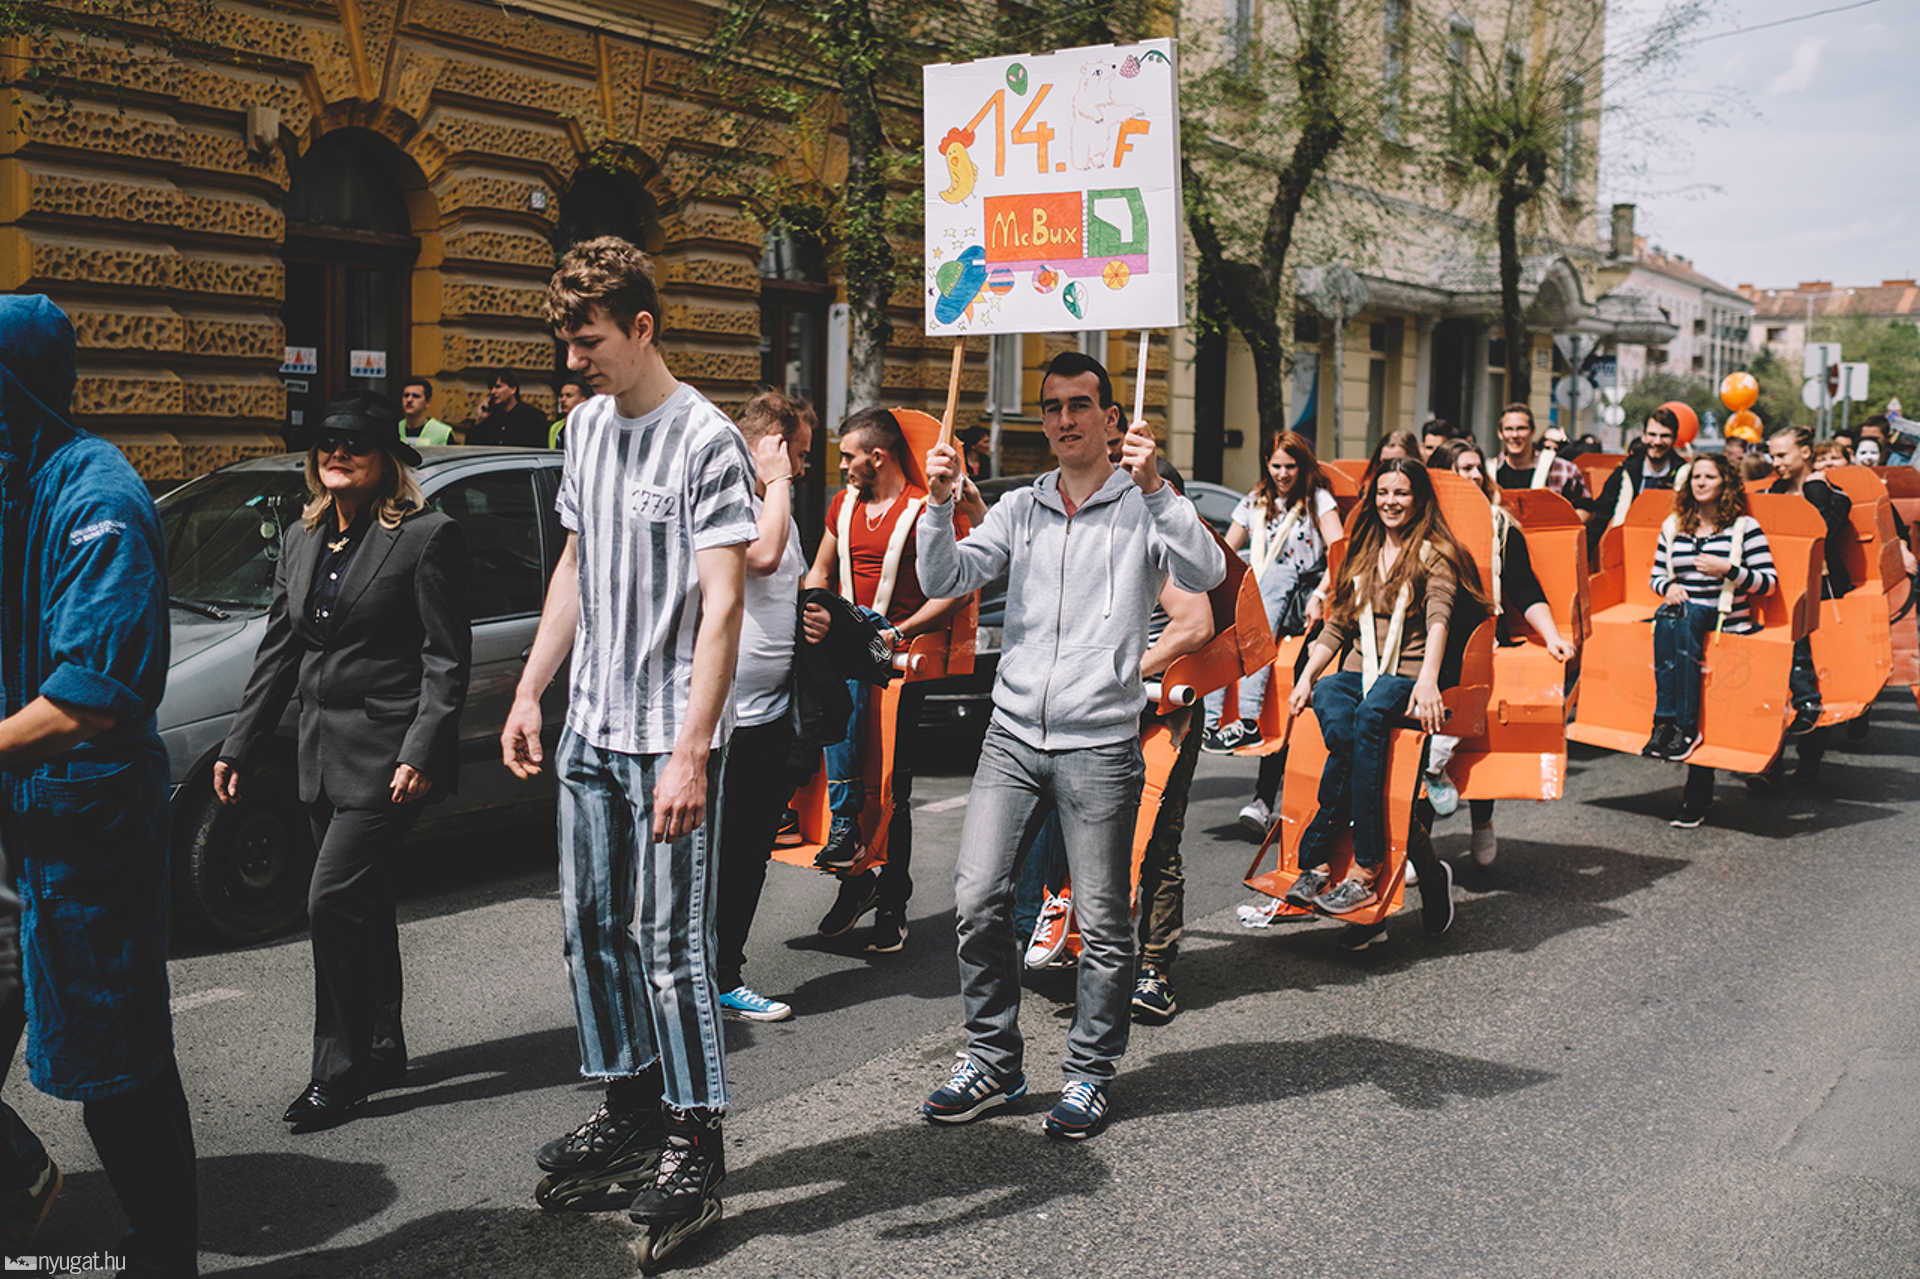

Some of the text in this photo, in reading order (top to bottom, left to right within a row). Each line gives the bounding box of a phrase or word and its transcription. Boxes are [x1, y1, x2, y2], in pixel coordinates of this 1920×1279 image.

[965, 83, 1151, 177] 14. F
[991, 207, 1077, 249] McBux
